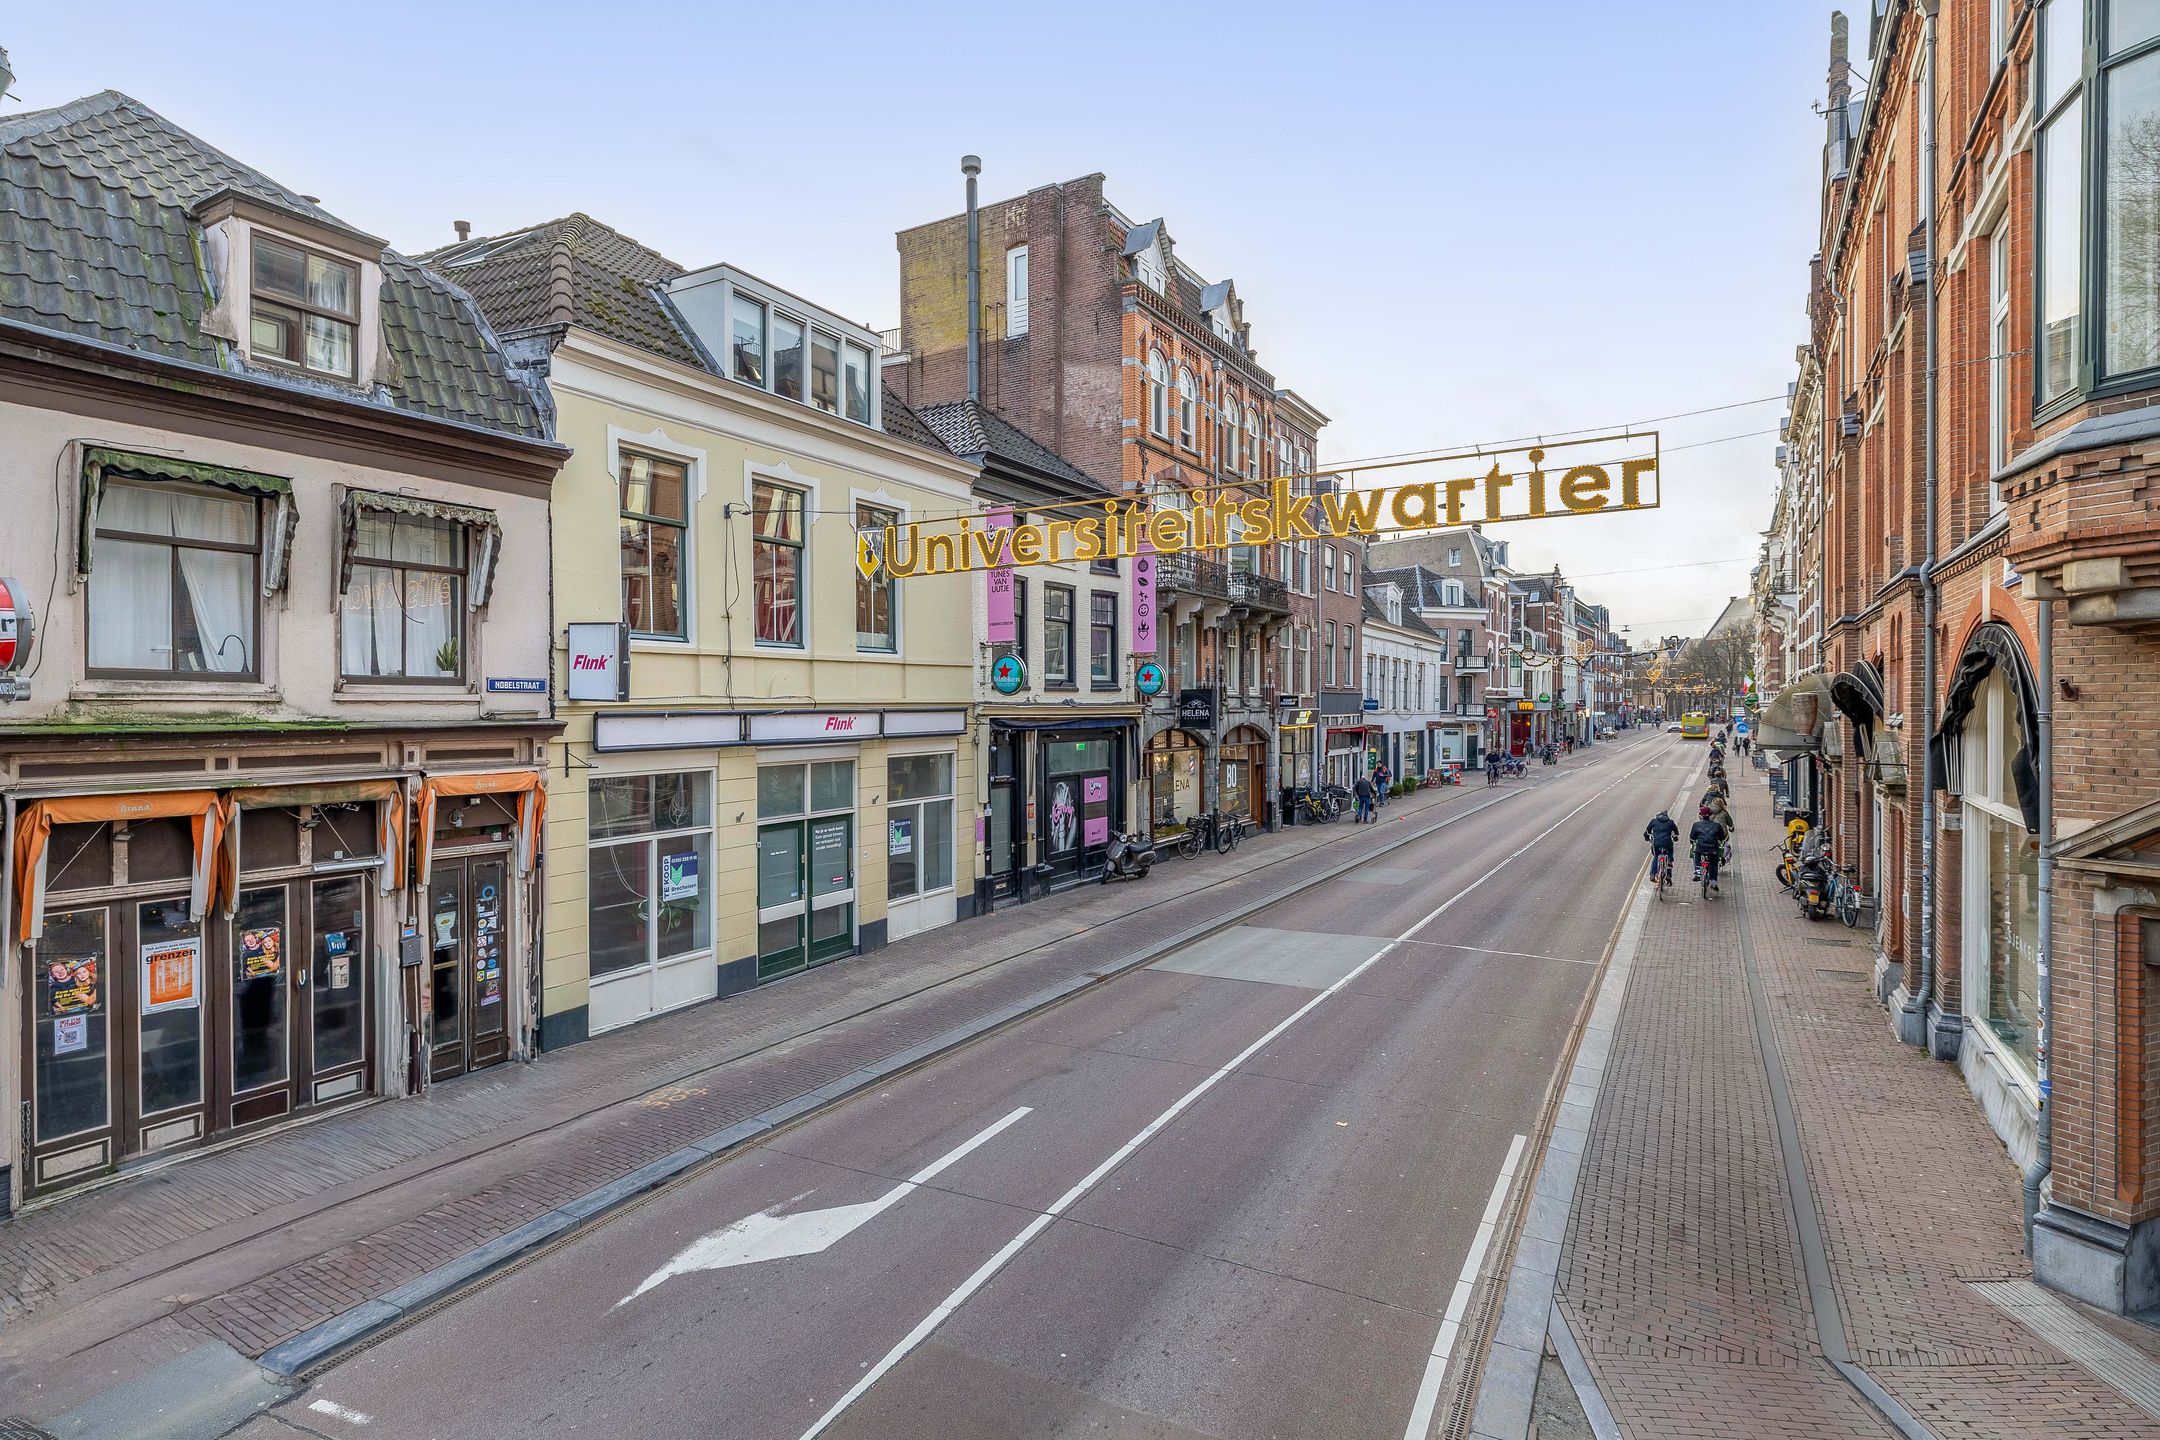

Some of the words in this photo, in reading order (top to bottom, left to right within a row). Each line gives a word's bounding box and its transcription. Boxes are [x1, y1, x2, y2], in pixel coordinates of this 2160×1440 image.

[885, 448, 1657, 577] Universiteitskwartier
[990, 570, 1010, 579] TUNES
[994, 578, 1007, 586] VAN
[992, 585, 1010, 594] UUTJE
[573, 655, 613, 670] Flink
[495, 681, 541, 690] NOBELSTRAAT
[1182, 709, 1210, 717] HELENA
[825, 716, 857, 730] Flink
[663, 886, 670, 900] TE
[145, 949, 197, 965] grenzen
